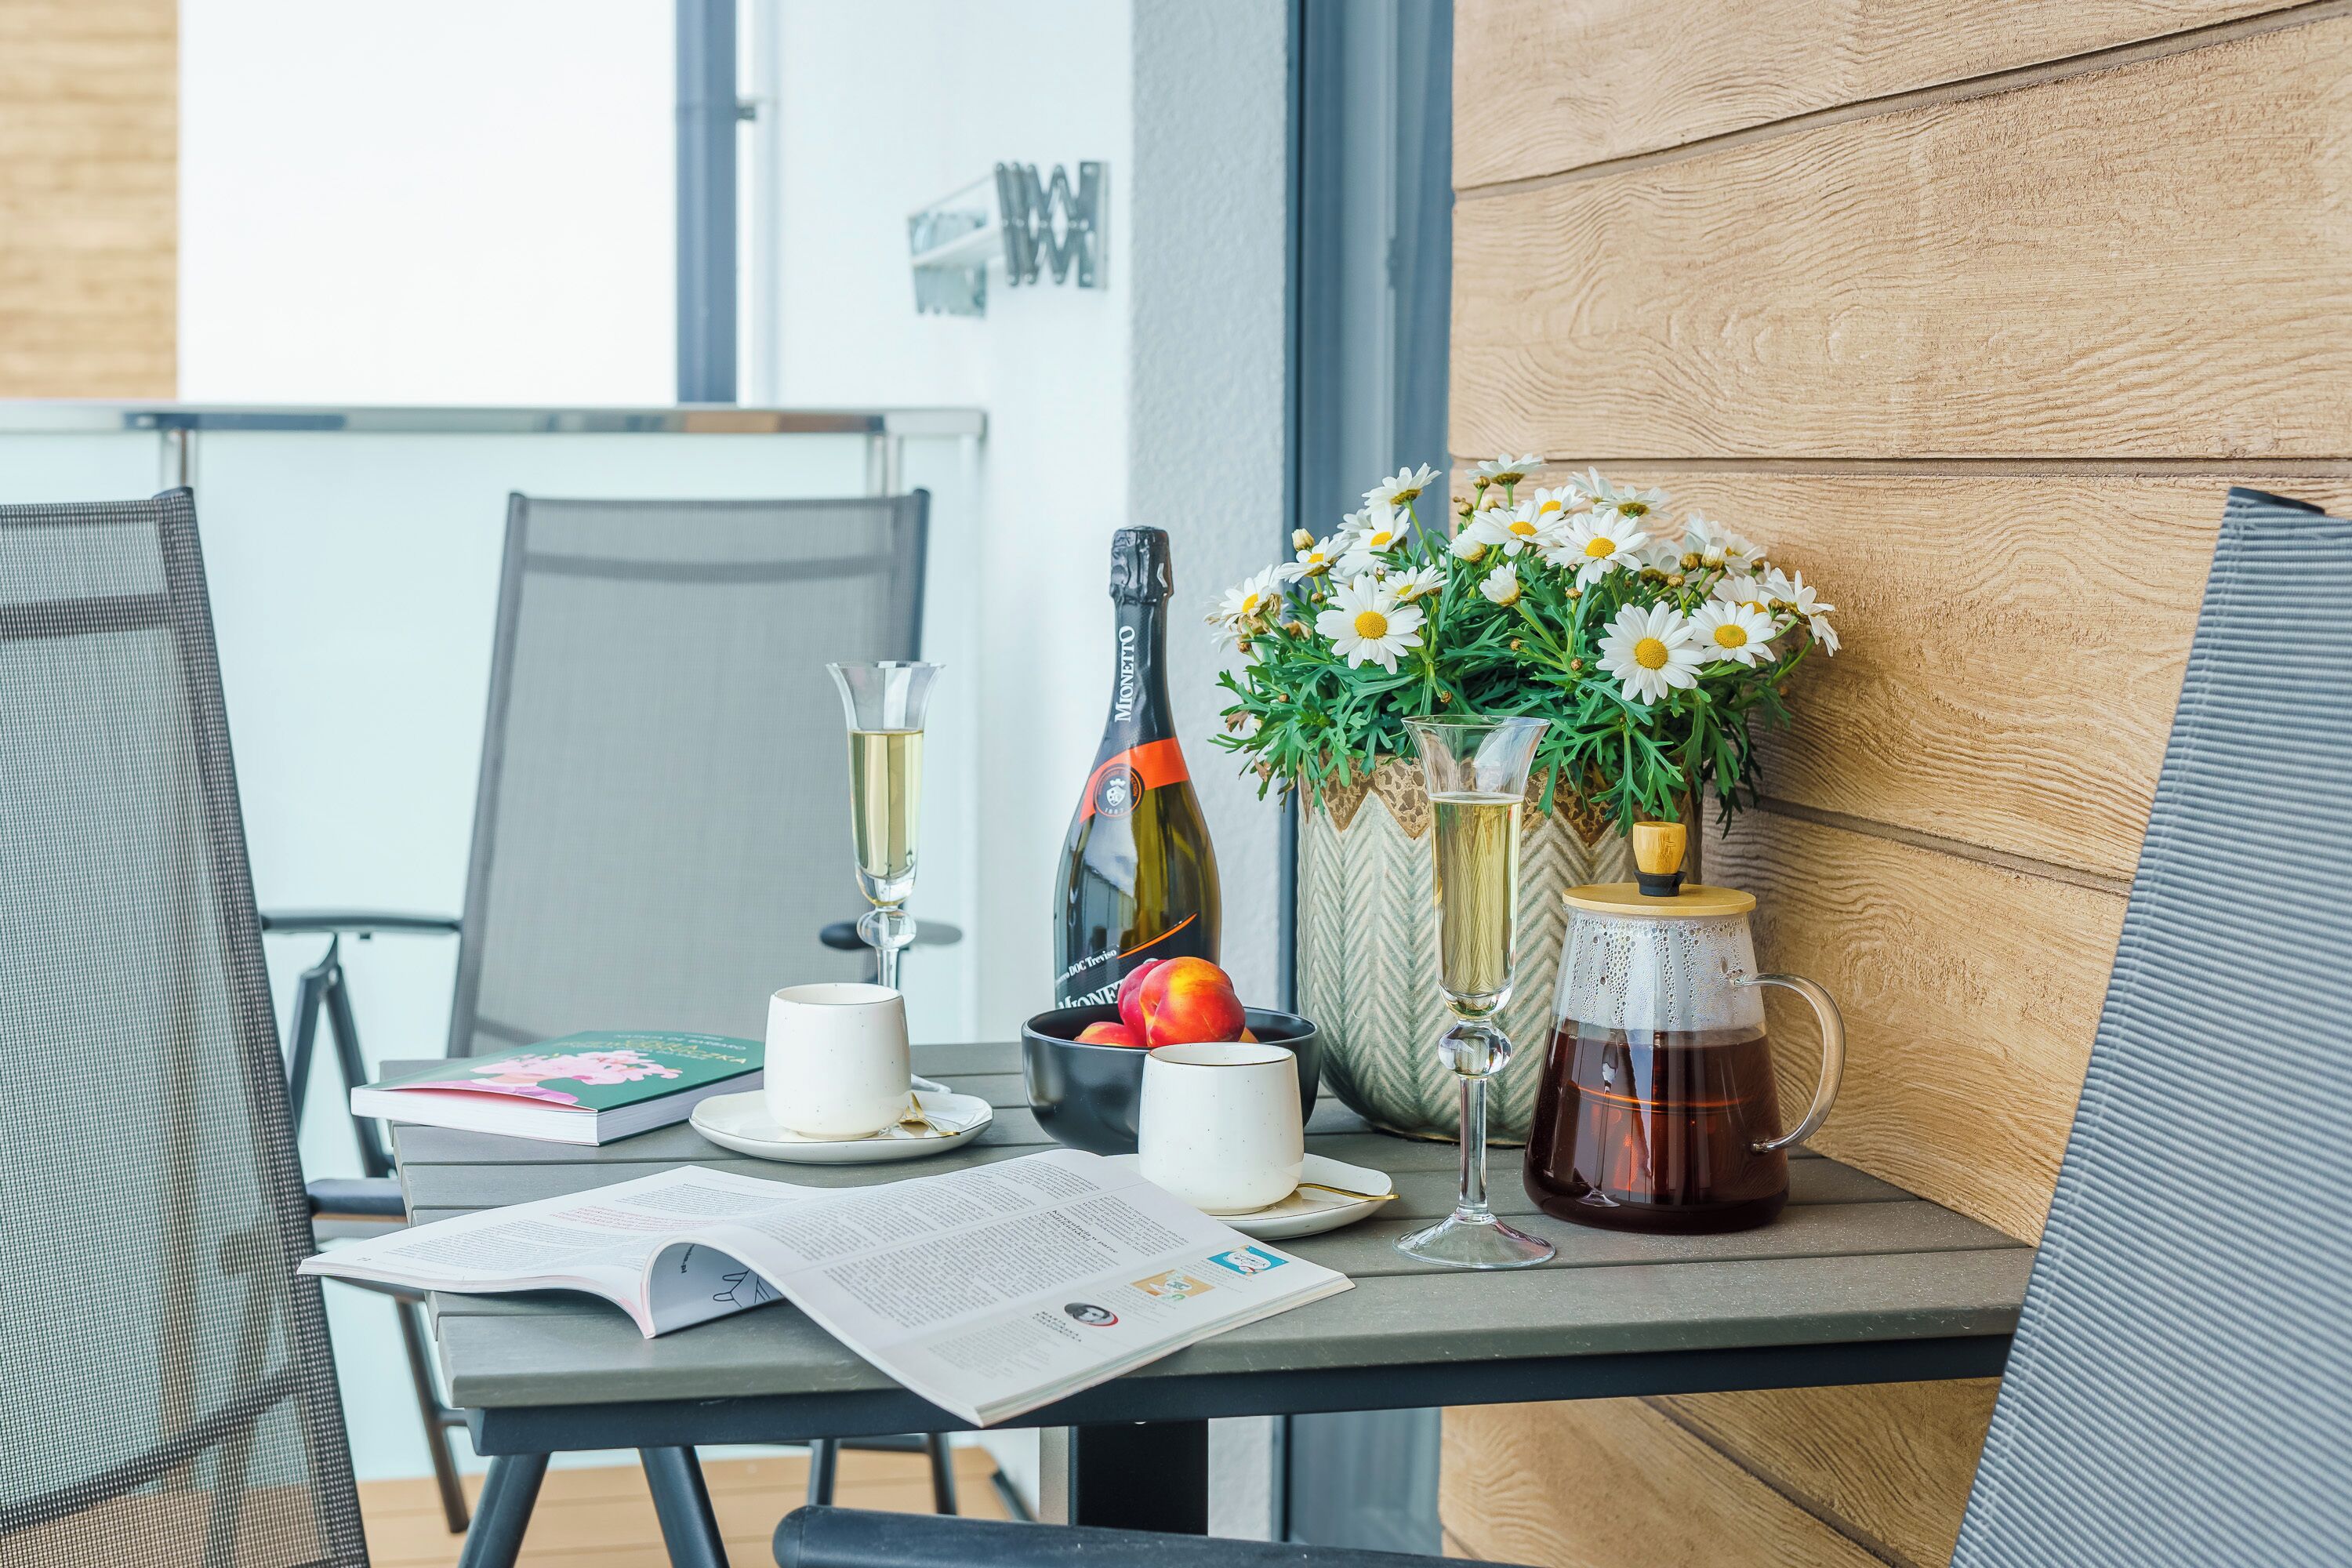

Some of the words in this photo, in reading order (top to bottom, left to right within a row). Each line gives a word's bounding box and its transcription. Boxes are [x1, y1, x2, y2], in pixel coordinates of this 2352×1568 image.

[1115, 626, 1135, 723] MIONETTO
[1069, 960, 1087, 977] DOC
[1085, 949, 1117, 967] Treviso
